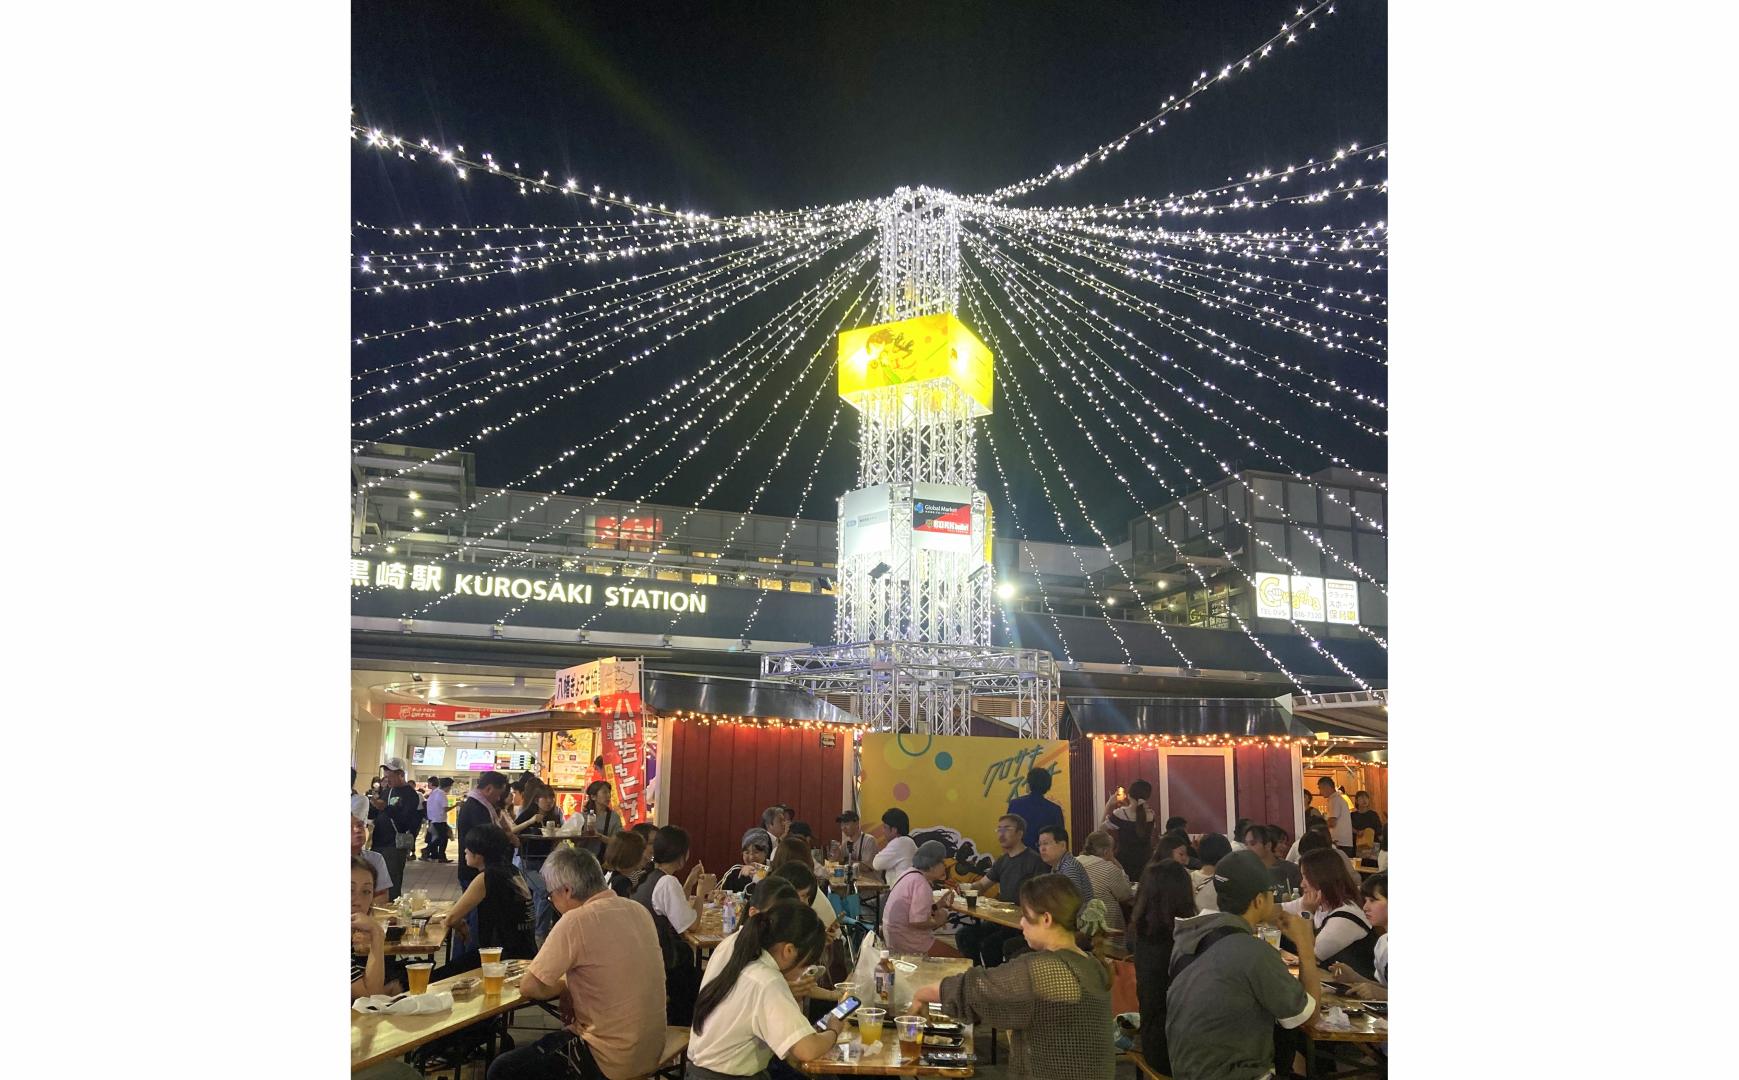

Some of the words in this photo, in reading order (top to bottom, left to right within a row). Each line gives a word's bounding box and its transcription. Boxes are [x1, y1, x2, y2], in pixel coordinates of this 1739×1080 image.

[924, 504, 940, 512] Global
[351, 559, 441, 592] 黒崎駅
[454, 573, 593, 605] KUROSAKI
[604, 586, 707, 614] STATION
[982, 744, 1044, 798] クロサキ
